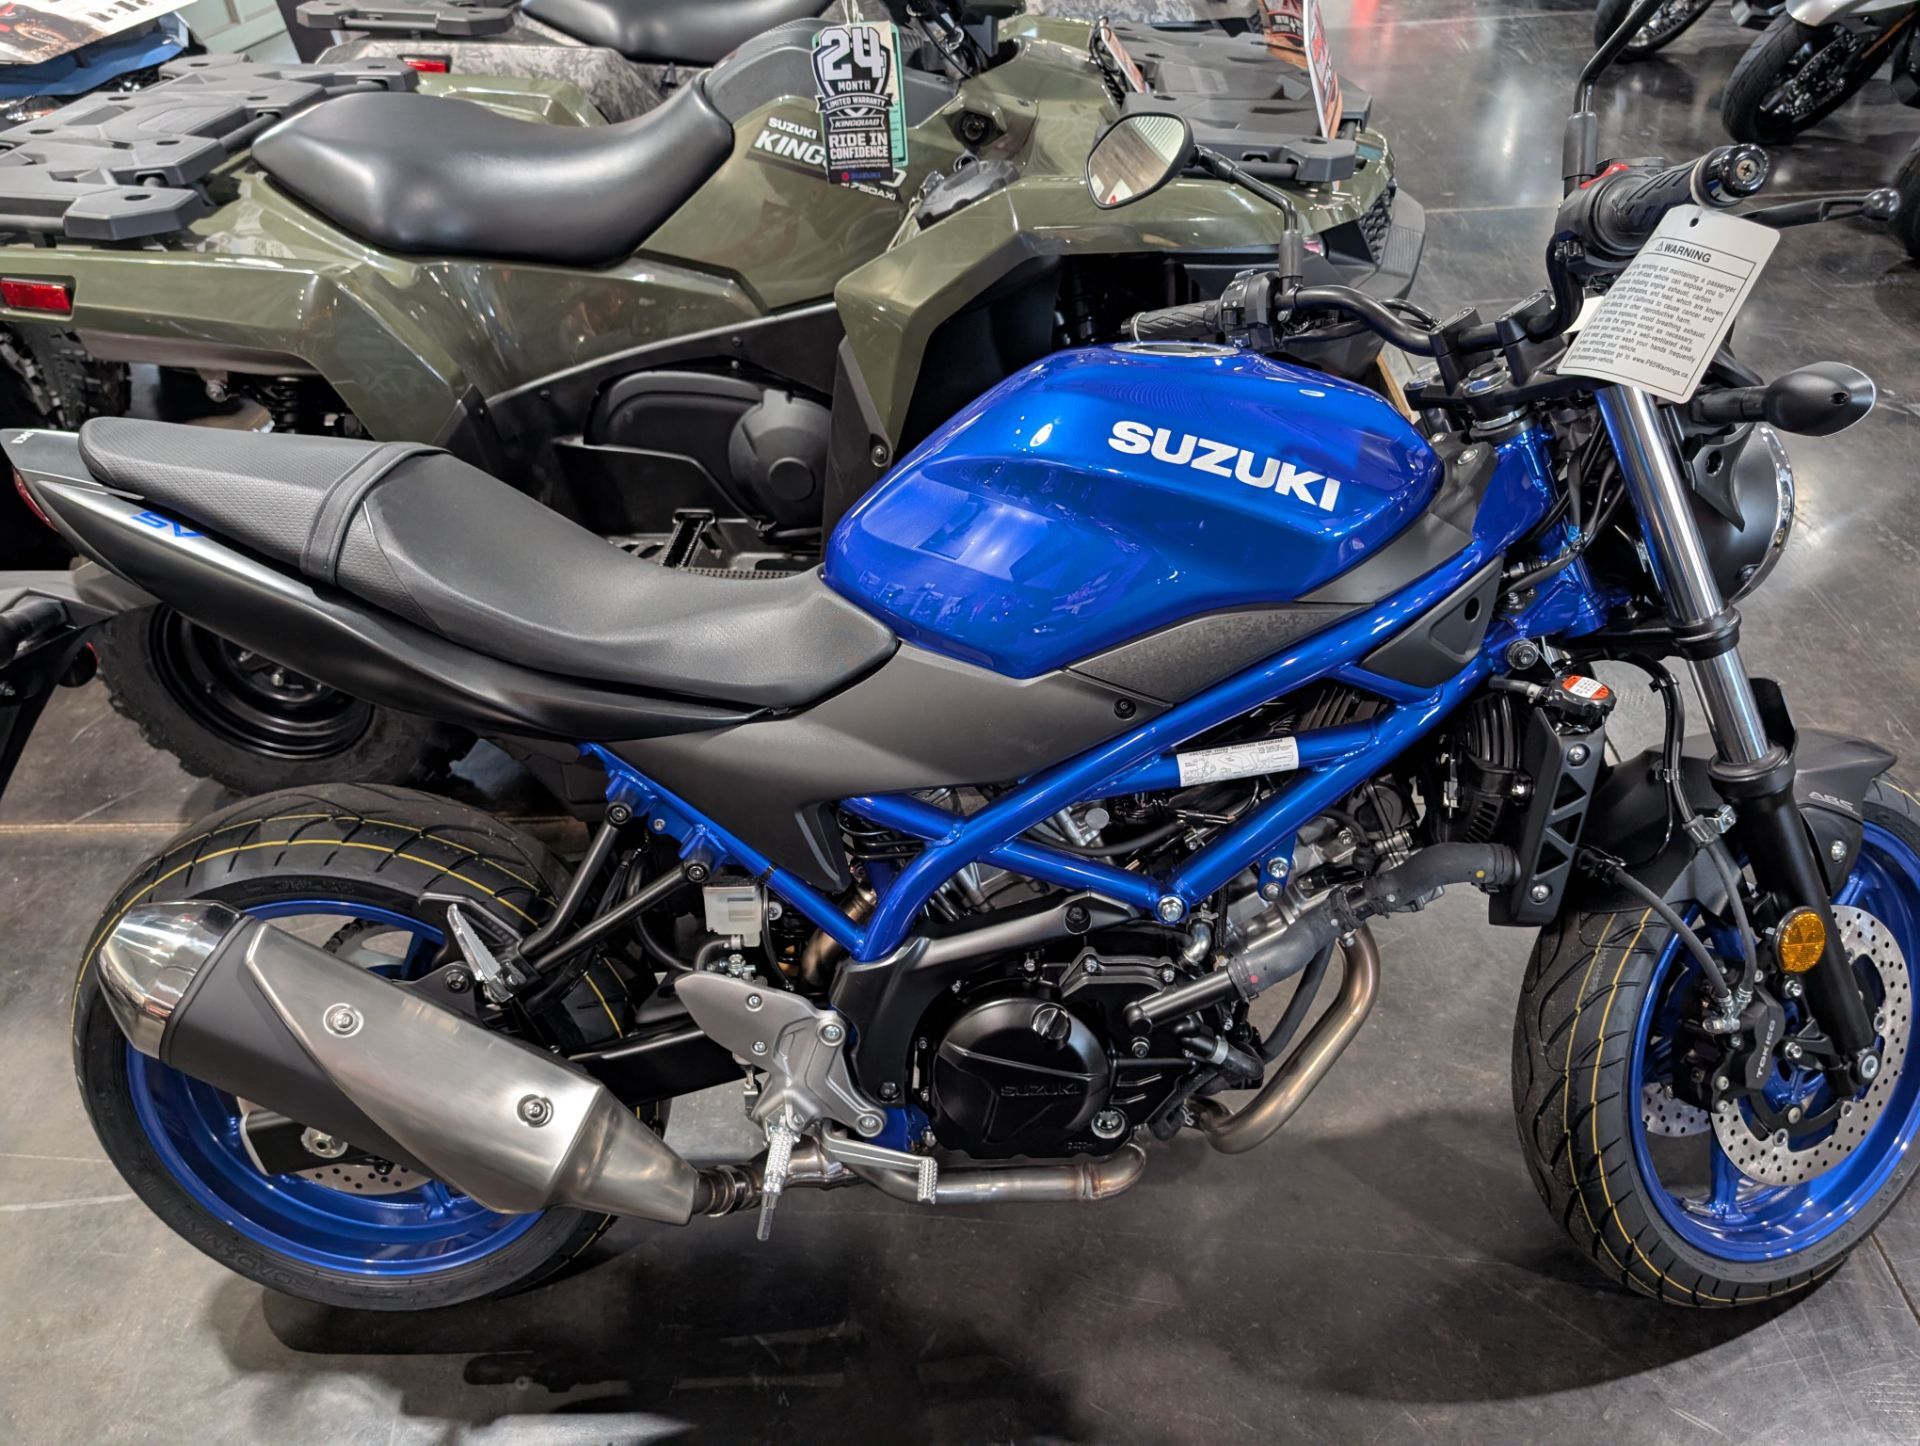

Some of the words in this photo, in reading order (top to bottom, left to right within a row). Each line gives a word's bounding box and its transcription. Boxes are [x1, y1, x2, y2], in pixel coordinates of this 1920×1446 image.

[821, 27, 885, 80] 24
[837, 80, 871, 92] MONTH
[825, 97, 852, 110] LIMITED
[852, 97, 886, 107] WARRANTY
[767, 117, 818, 139] SUZUKI
[835, 118, 880, 128] KINGQUAD
[828, 133, 867, 148] RIDE
[869, 132, 888, 146] IN
[829, 146, 889, 160] CONFIDENCE
[1664, 243, 1712, 263] WARNING
[1669, 268, 1700, 283] maintaining
[1706, 279, 1737, 293] passenger
[1683, 282, 1703, 293] expose
[1705, 288, 1717, 297] you
[1649, 282, 1666, 290] engine
[1667, 286, 1690, 298] exhaust,
[1692, 293, 1712, 303] carbon
[1633, 295, 1655, 305] California
[1663, 303, 1680, 312] cause
[1681, 308, 1702, 319] cancer
[1702, 313, 1715, 323] and
[1643, 306, 1675, 319] reproductive
[1675, 315, 1691, 324] harm.
[1661, 292, 1674, 301] lead,
[1676, 297, 1692, 306] which
[1694, 303, 1704, 311] are
[1705, 306, 1724, 317] known
[1620, 319, 1636, 327] engine
[1637, 322, 1655, 332] except
[1665, 329, 1694, 345] necessary,
[1640, 314, 1655, 323] avoid
[1656, 318, 1682, 332] breathing
[1683, 327, 1706, 339] exhaust,
[1591, 347, 1615, 356] information
[1618, 344, 1637, 353] vehicle.
[1636, 339, 1649, 347] your
[1649, 342, 1667, 354] hands
[1668, 349, 1696, 364] frequently
[1638, 331, 1678, 348] well-ventilated
[1678, 343, 1692, 353] area
[1108, 420, 1341, 512] SUZUKI
[1755, 1019, 1776, 1079] TOKICO
[1000, 1083, 1081, 1097] SUZUKI
